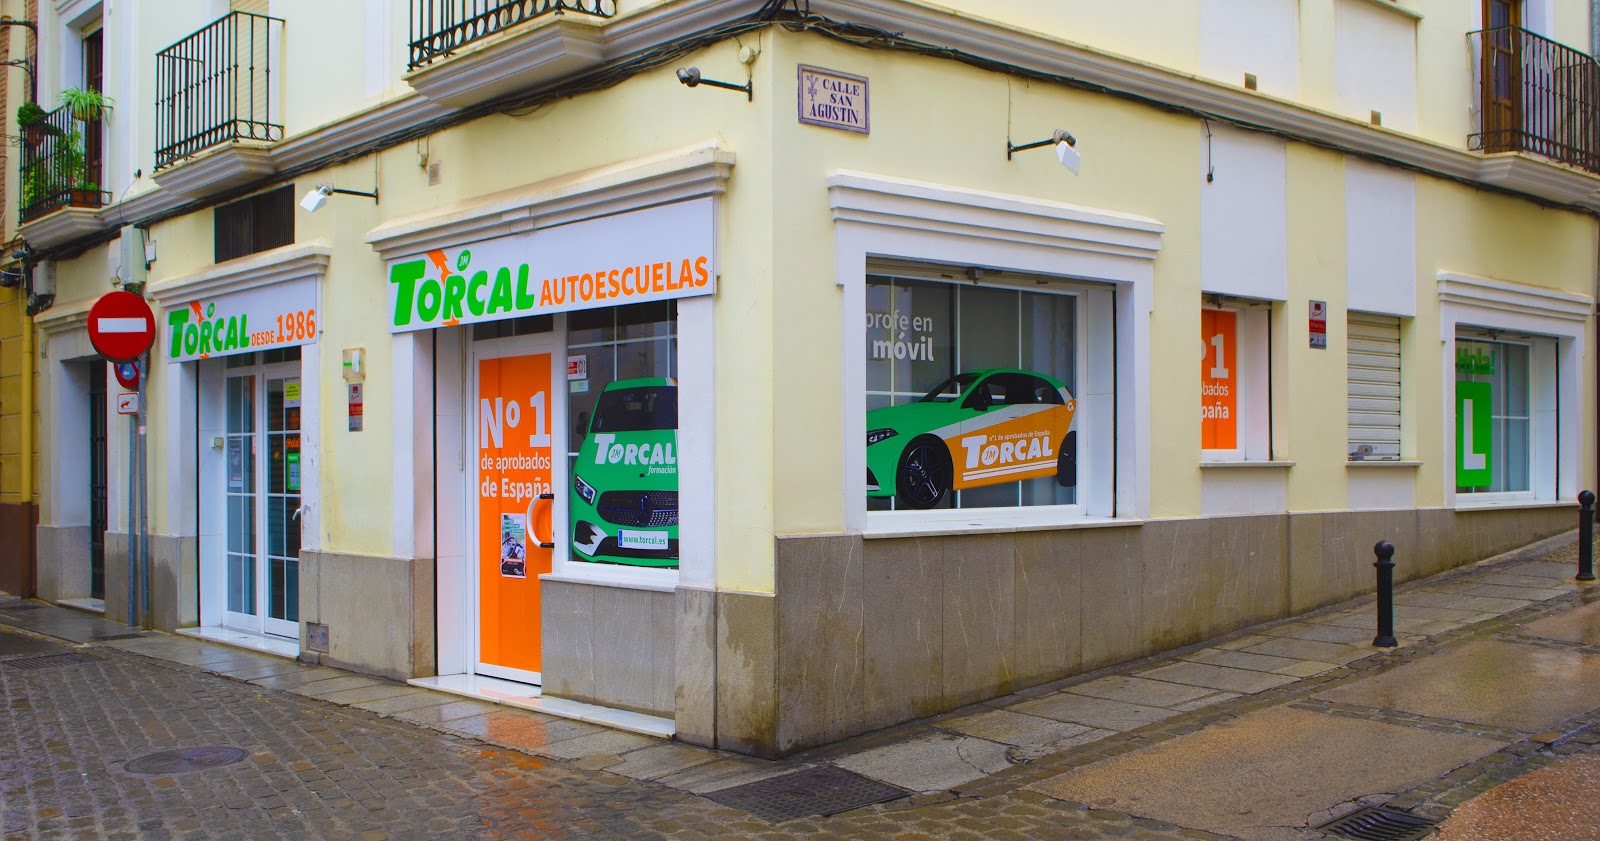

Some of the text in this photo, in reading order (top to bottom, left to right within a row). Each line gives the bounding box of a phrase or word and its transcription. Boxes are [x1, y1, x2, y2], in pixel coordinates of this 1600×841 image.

[822, 79, 860, 97] CALLE
[829, 93, 853, 107] SAN
[810, 102, 859, 124] AGUSTIN
[390, 256, 709, 326] TORCAL AUTOESCUELAS
[168, 308, 316, 359] TORCAL DESDE 1986
[912, 316, 933, 332] en
[873, 331, 934, 361] móvil
[529, 391, 551, 448] 1
[1463, 399, 1486, 470] L
[481, 452, 551, 474] de aprobados
[594, 434, 676, 465] TORCAL
[962, 435, 1053, 469] TORCAL
[647, 466, 676, 476] formación
[481, 476, 551, 503] de España
[623, 536, 666, 545] www.torcal.es
